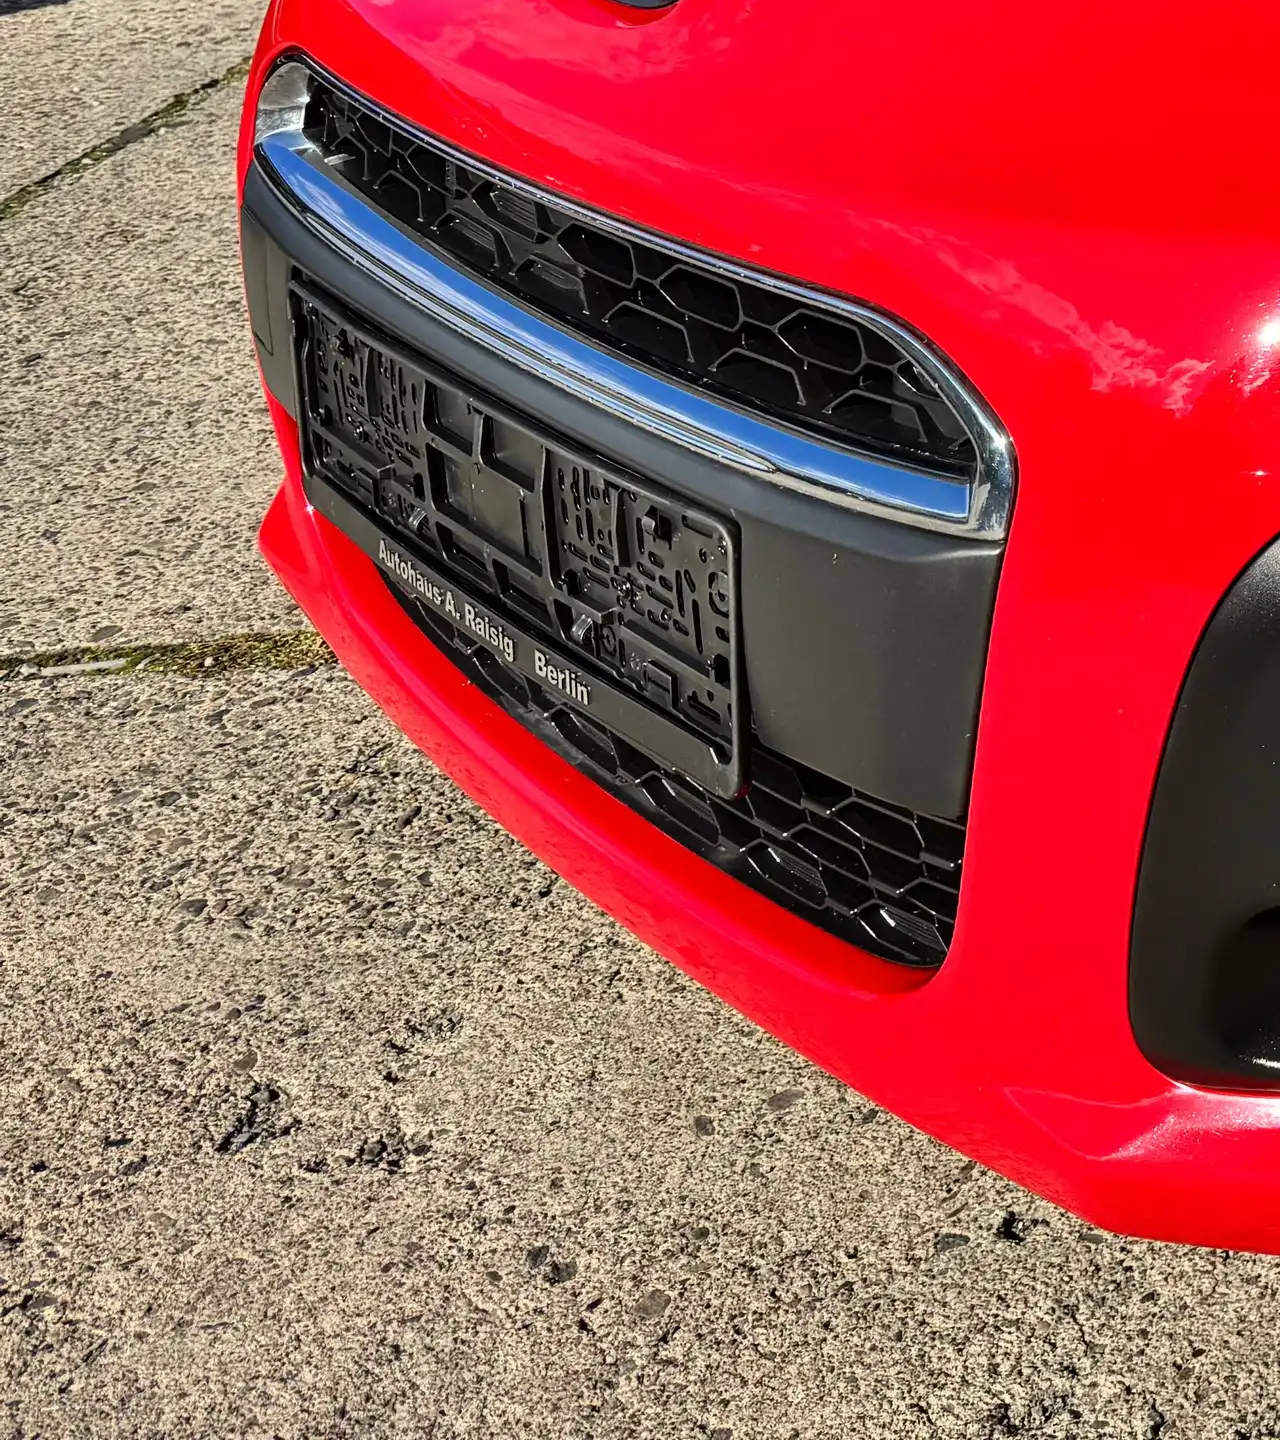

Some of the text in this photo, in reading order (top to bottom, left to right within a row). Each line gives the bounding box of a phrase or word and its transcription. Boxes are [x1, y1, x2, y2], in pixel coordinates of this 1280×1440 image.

[378, 539, 443, 605] Autohaus
[464, 603, 516, 662] Raisig
[534, 649, 590, 706] Berlin
